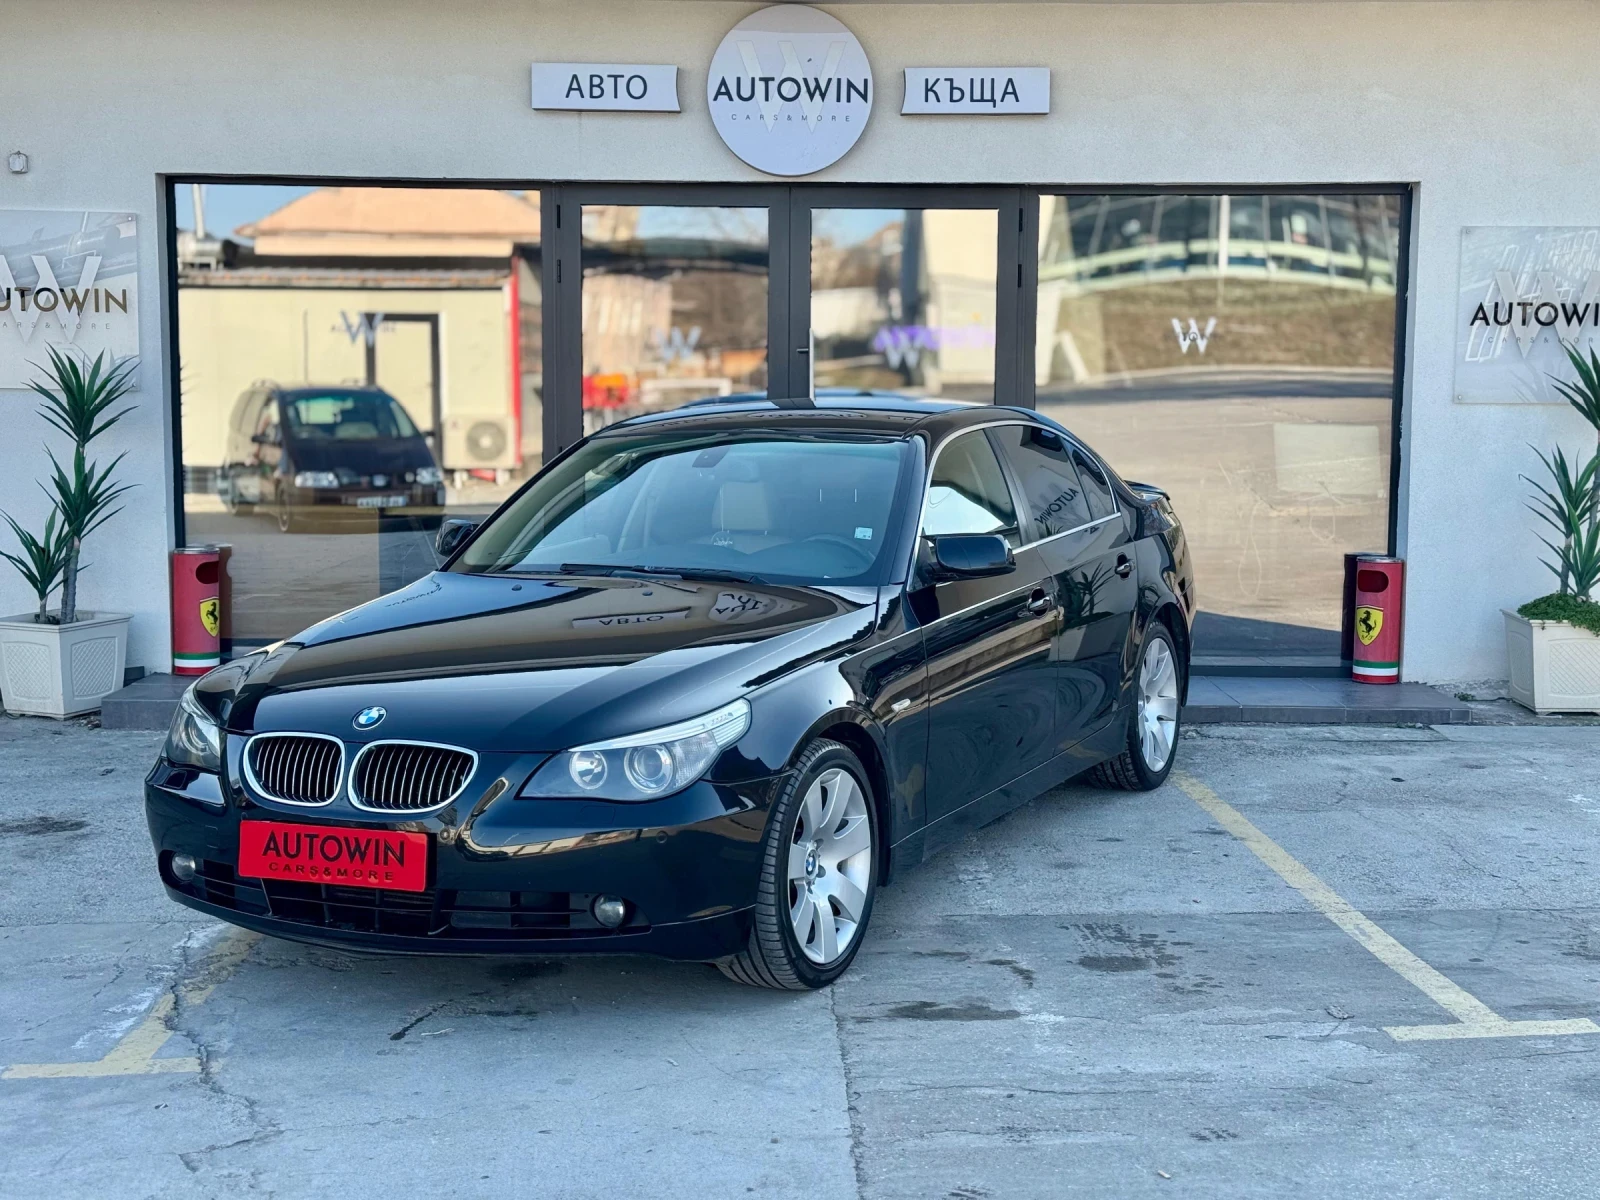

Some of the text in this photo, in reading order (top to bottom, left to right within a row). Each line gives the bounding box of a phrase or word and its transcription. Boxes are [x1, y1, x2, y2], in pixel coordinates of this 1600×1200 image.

[565, 74, 648, 100] АВТО
[713, 76, 869, 104] AUTOWIN
[924, 78, 1020, 108] КЪЩА
[731, 114, 850, 122] CARS&MORE
[262, 830, 405, 868] AUTOWIN
[268, 862, 394, 881] CARS&MORE
